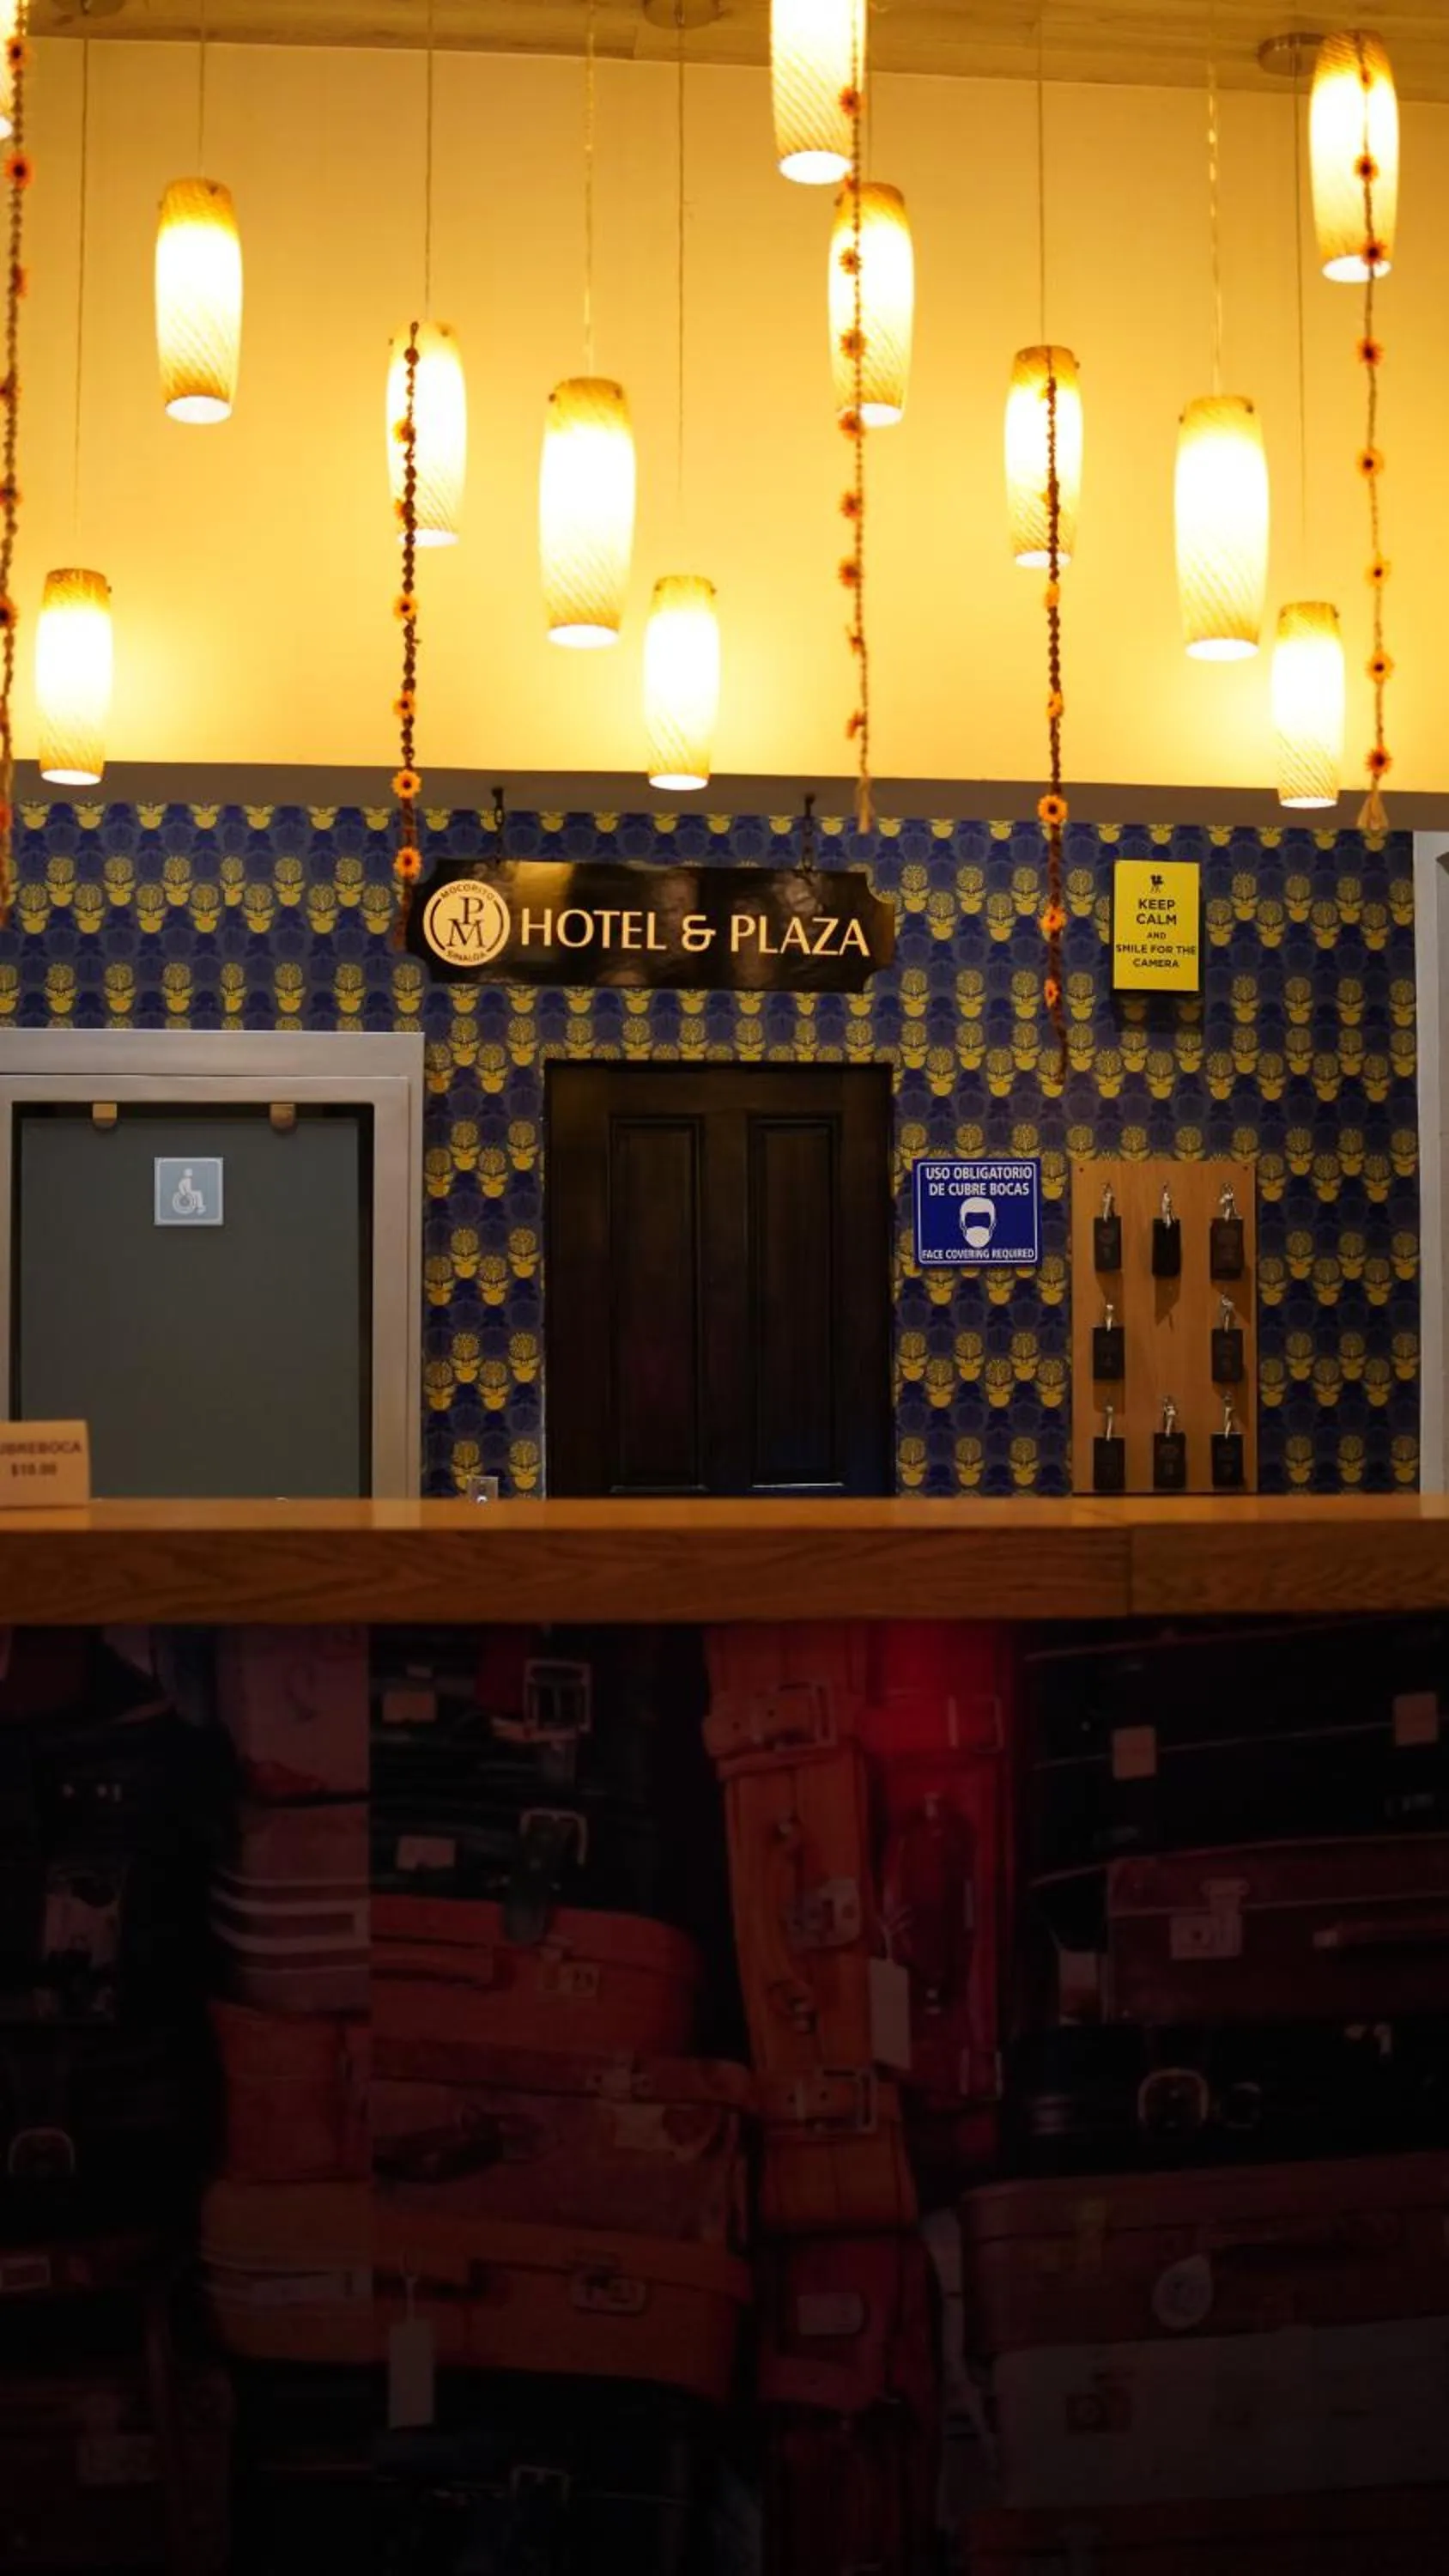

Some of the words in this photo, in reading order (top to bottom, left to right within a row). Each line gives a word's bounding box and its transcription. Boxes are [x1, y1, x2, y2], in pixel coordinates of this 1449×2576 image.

[1137, 899, 1176, 910] KEEP
[1136, 913, 1178, 925] CALM
[521, 908, 666, 951] HOTEL
[682, 914, 716, 952] &
[731, 914, 870, 957] PLAZA
[1115, 944, 1148, 954] SMILE
[1150, 945, 1173, 954] FOR
[1176, 945, 1197, 956] THE
[1132, 957, 1180, 969] CAMERA
[925, 1167, 950, 1180] USO
[954, 1167, 1033, 1180] OBLIGATORIO
[929, 1182, 945, 1196] DE
[948, 1182, 986, 1196] CUBRE
[990, 1182, 1030, 1196] BOCAS
[922, 1249, 943, 1260] FACE
[945, 1249, 990, 1260] COVERING
[991, 1248, 1034, 1259] REQUIRED
